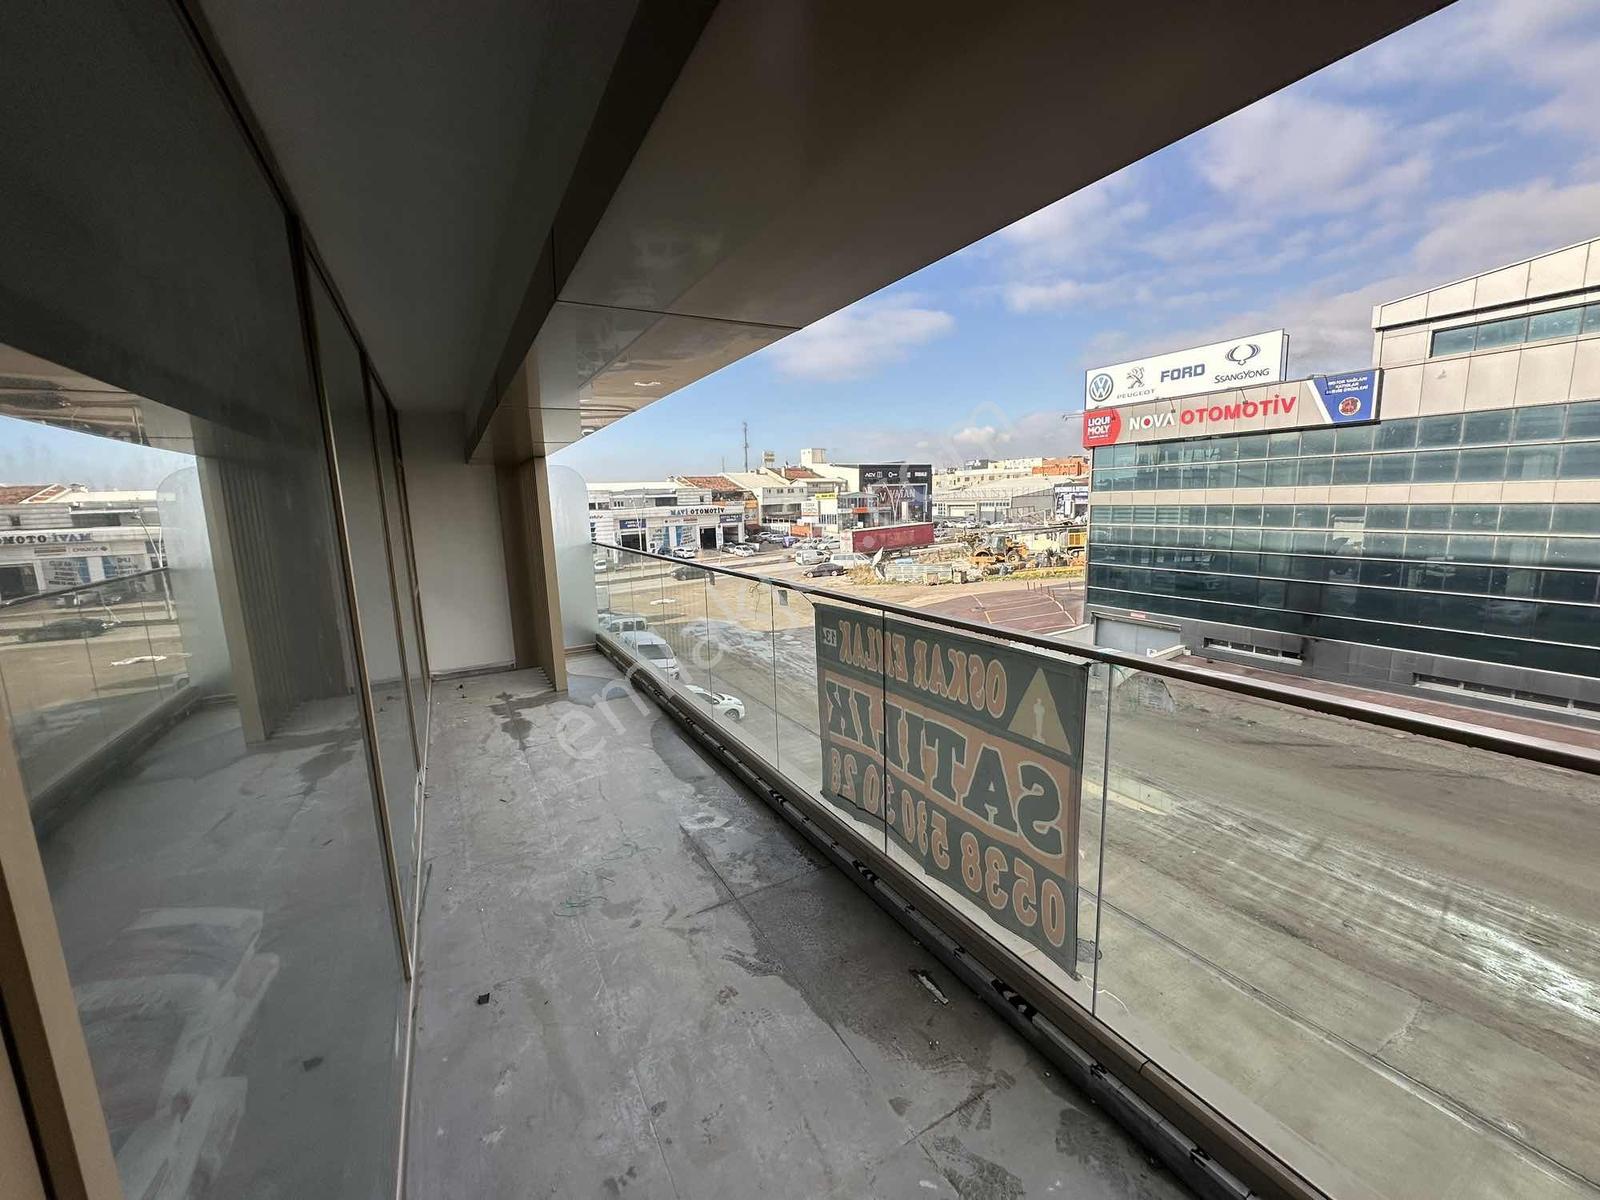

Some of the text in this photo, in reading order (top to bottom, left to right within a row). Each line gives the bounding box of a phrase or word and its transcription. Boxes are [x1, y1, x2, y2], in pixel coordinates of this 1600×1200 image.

[1160, 363, 1205, 383] FORD
[1116, 388, 1156, 399] PEUGEOT
[1128, 393, 1297, 431] NOVA OTOMOTİV
[1087, 416, 1111, 427] LIQUI
[1087, 425, 1110, 436] MOLY
[670, 507, 725, 516] MAVİ OTOMOTİV
